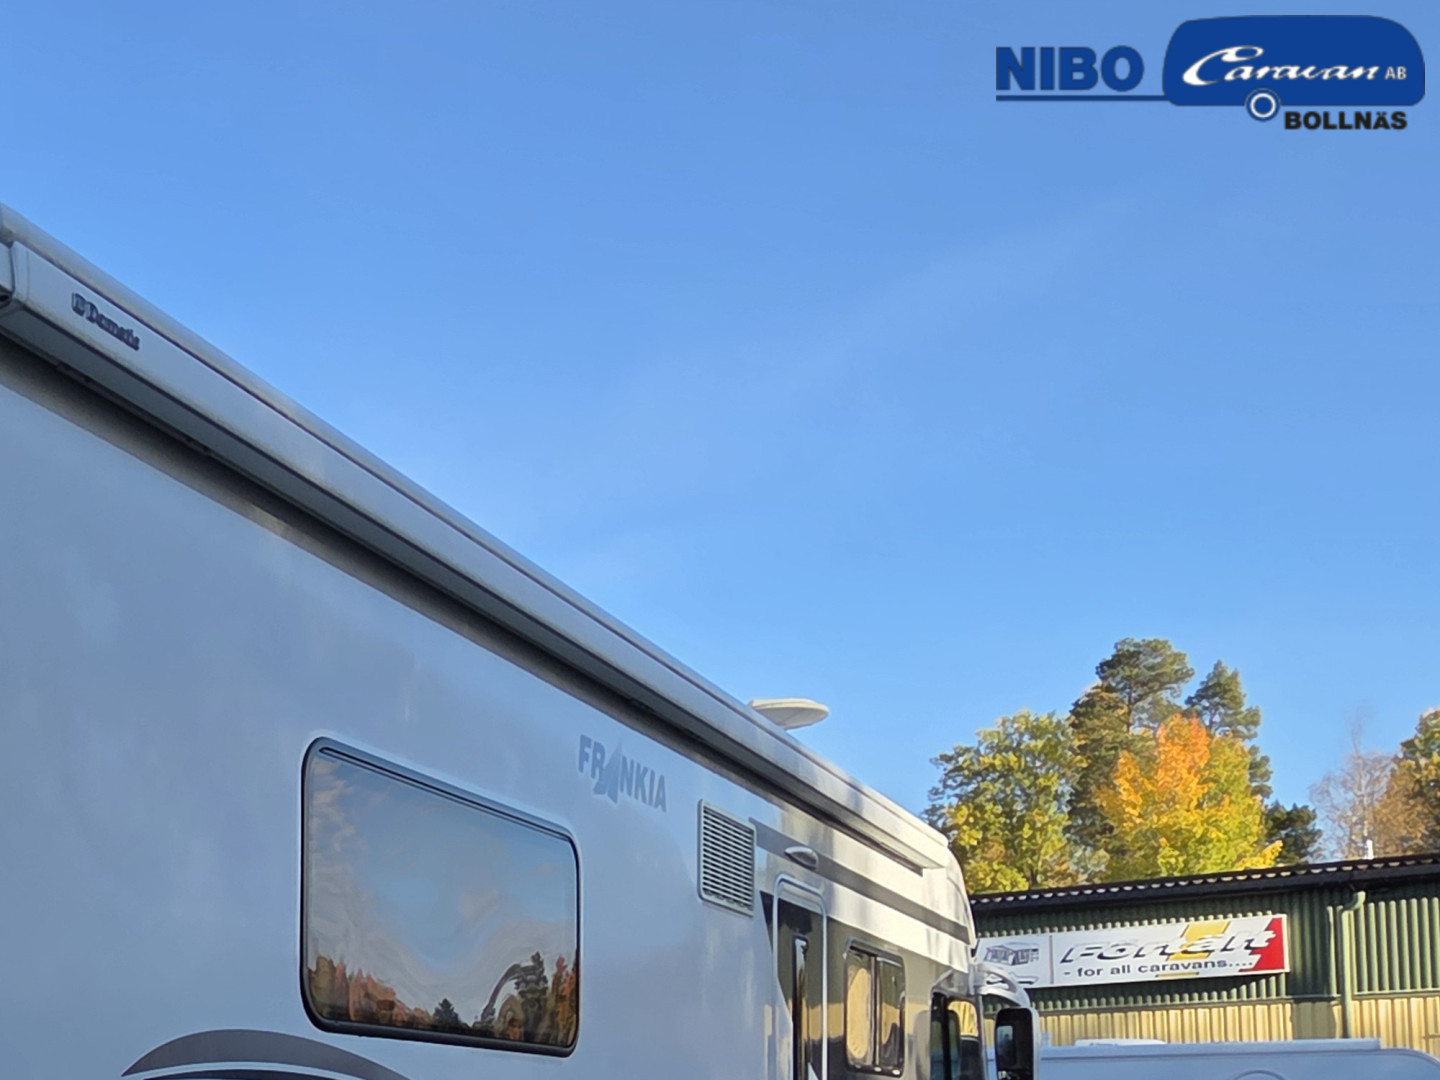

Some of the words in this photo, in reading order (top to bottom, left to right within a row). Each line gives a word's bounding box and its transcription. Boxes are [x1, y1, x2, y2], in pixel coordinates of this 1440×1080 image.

[578, 734, 667, 813] FRANKIA
[1077, 967, 1103, 977] for
[1110, 963, 1131, 975] all
